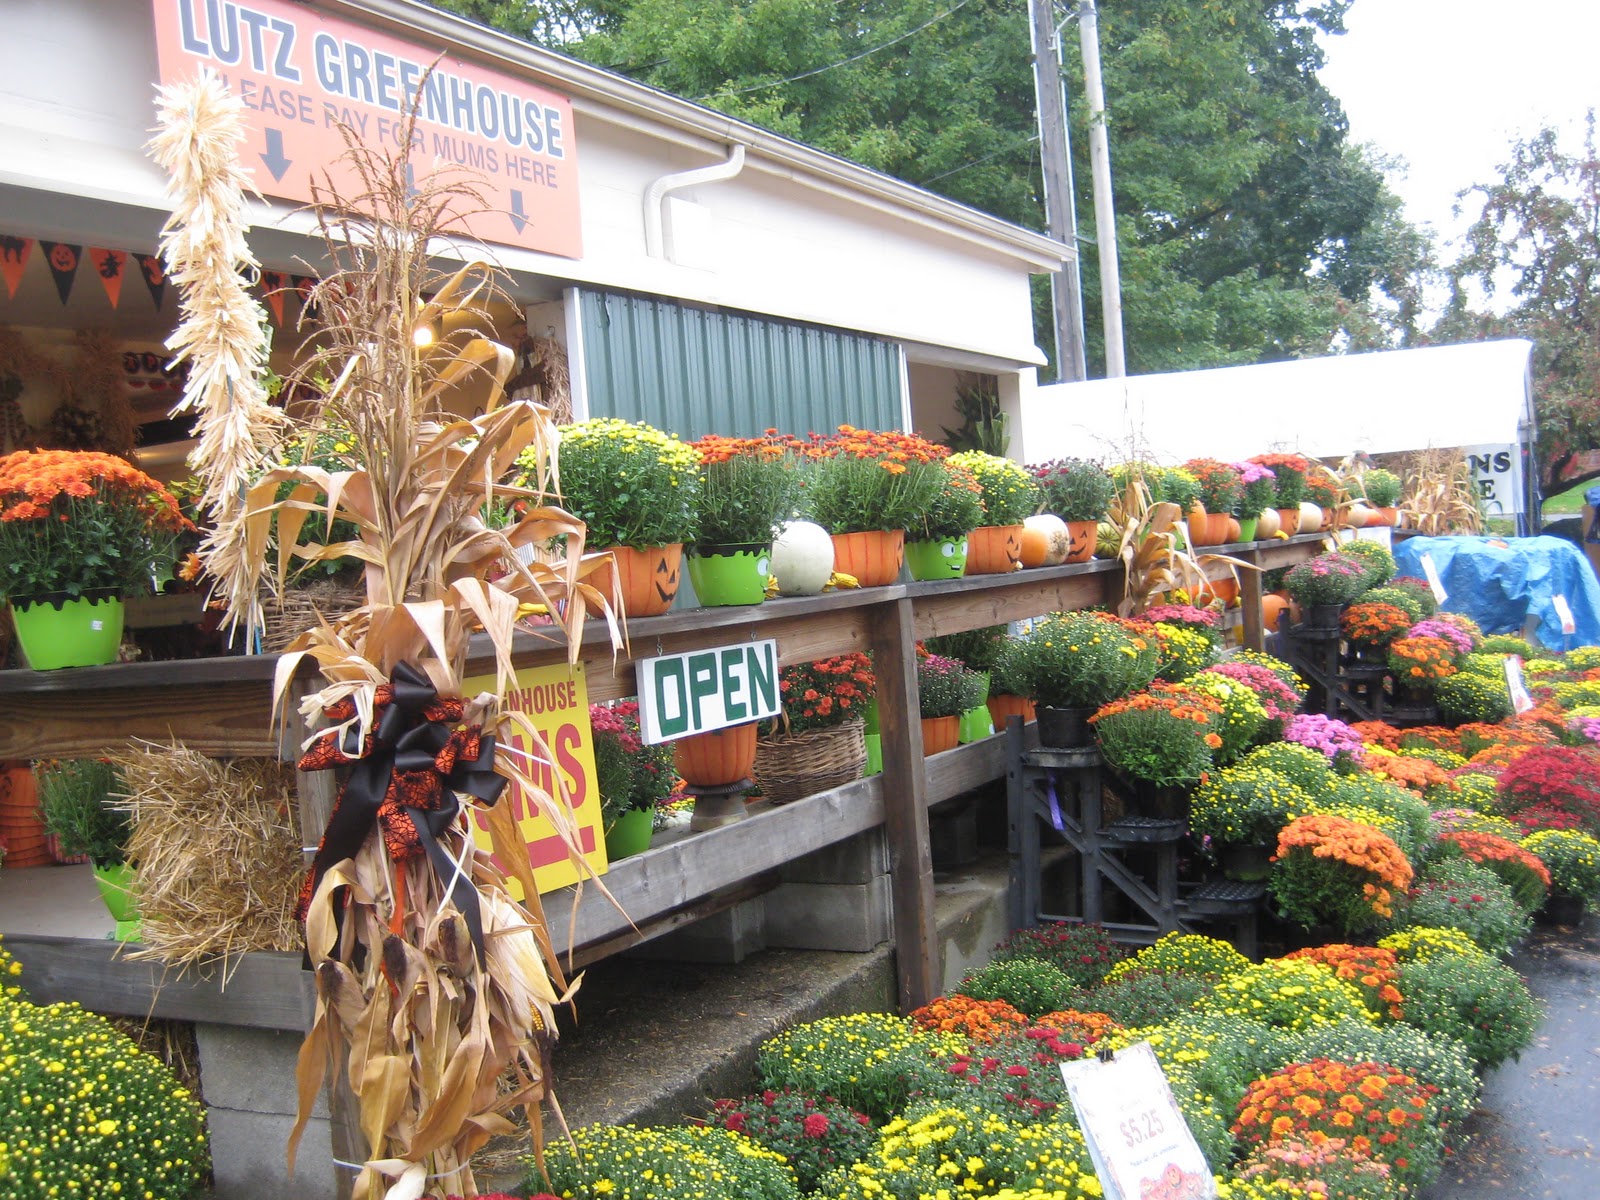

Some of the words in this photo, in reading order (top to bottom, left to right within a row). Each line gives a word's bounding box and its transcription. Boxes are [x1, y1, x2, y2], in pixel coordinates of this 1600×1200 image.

[179, 0, 301, 83] LUTZ
[315, 33, 564, 158] GREENHOUSE
[204, 68, 316, 126] EASE
[323, 102, 369, 139] PAY
[433, 133, 500, 174] MUMS
[505, 152, 558, 189] HERE
[655, 643, 776, 737] OPEN
[1119, 1108, 1165, 1149] $5.25
